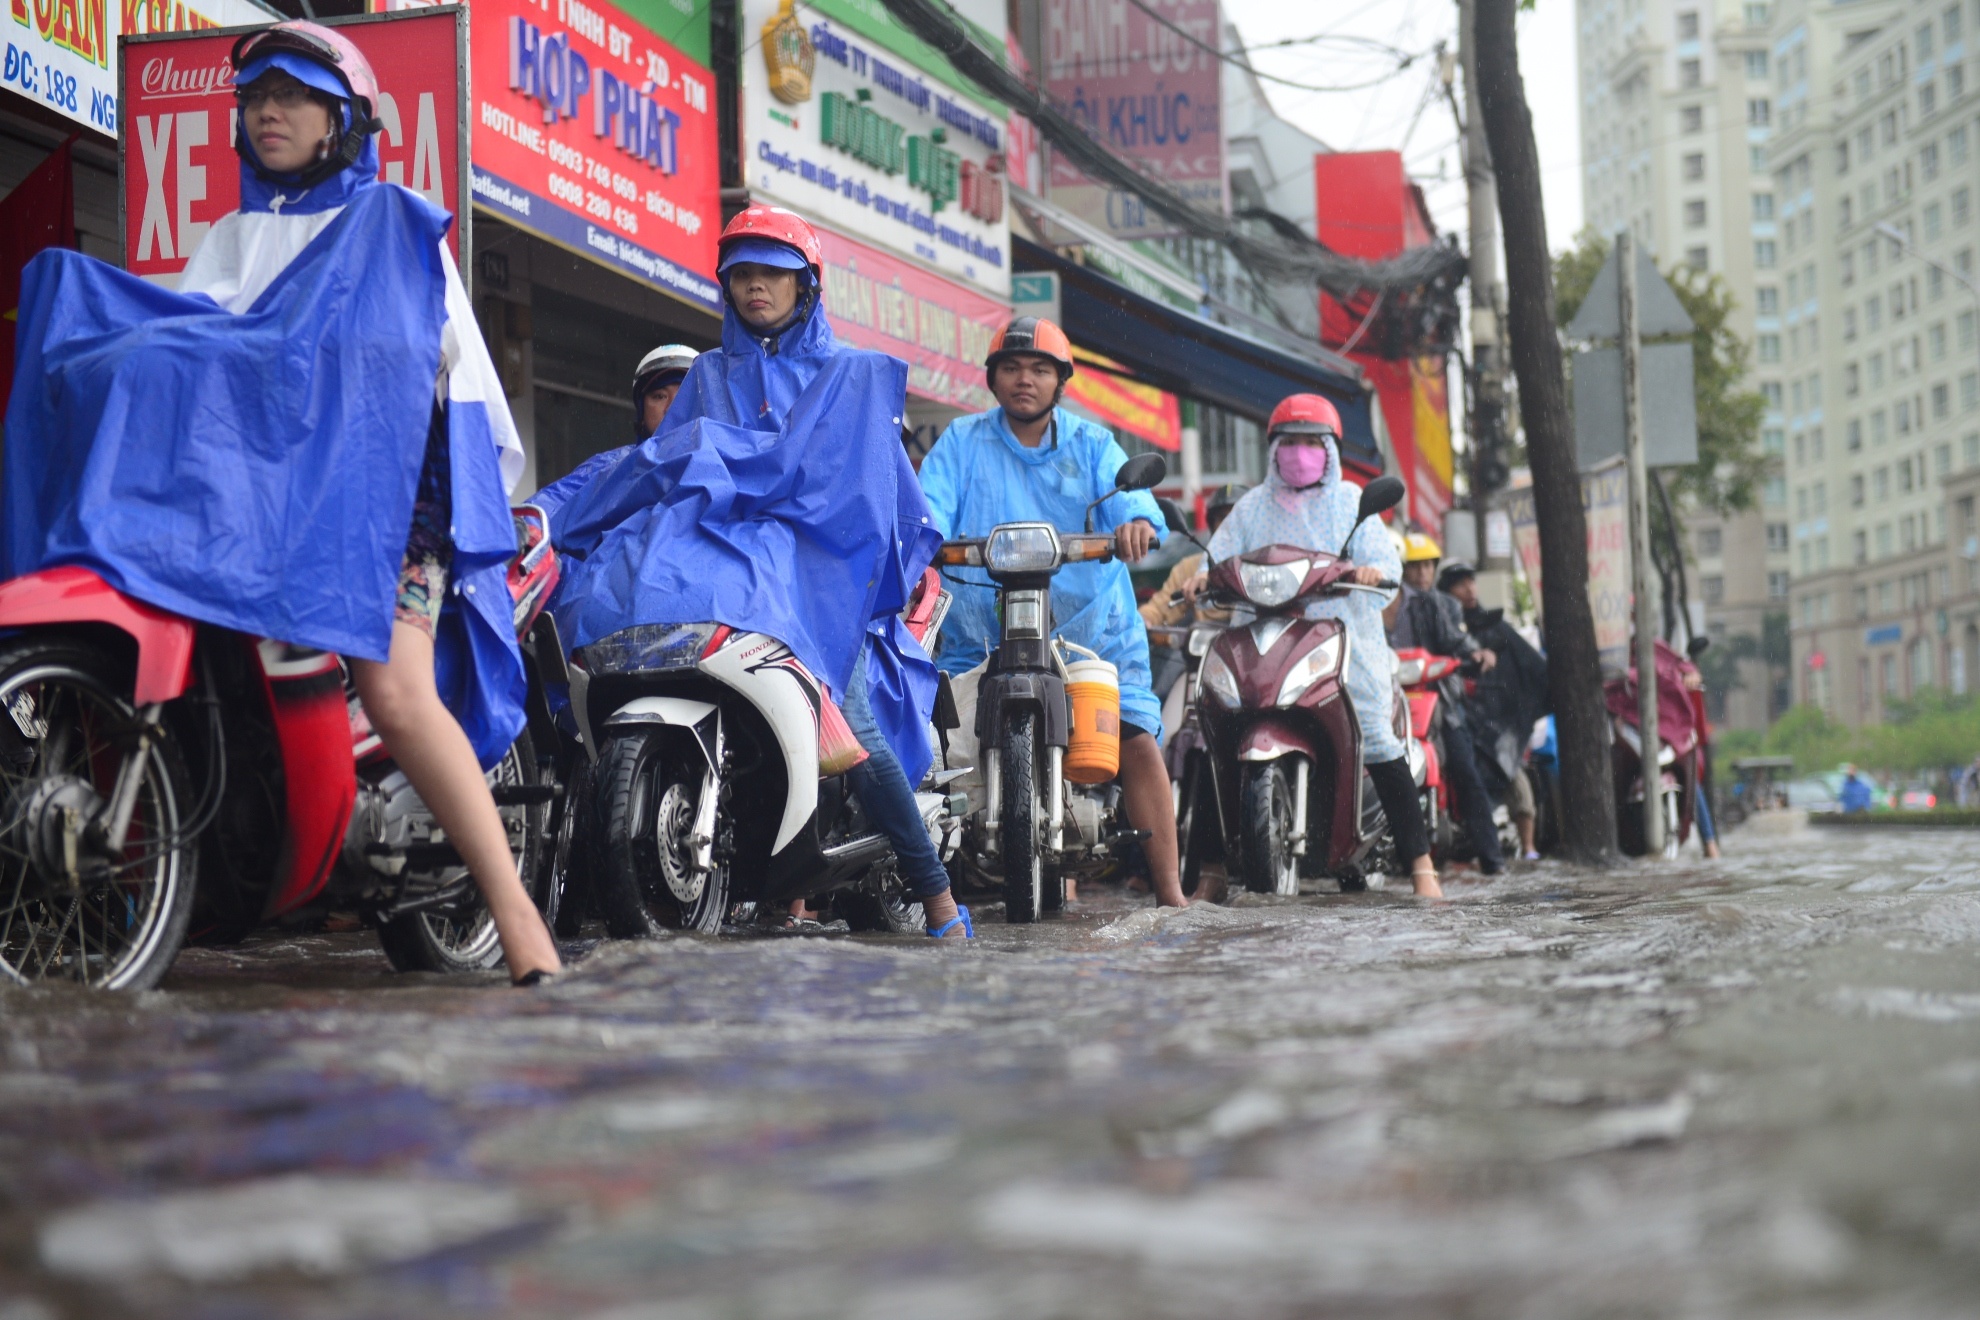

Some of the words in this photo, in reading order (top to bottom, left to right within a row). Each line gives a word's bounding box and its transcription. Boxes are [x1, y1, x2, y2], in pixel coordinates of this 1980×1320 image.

[4, 42, 38, 94] ĐC:
[45, 64, 78, 113] 188
[90, 86, 117, 133] NG
[141, 57, 237, 96] Chuyê
[508, 15, 590, 124] HỢP
[593, 67, 681, 177] PHÁT
[557, 0, 605, 48] TNHH
[608, 24, 632, 64] ĐT
[646, 49, 670, 88] XD
[681, 73, 707, 114] TM
[852, 46, 868, 77] TY
[481, 101, 546, 156] HOTLINE:
[548, 138, 584, 174] 0903
[585, 158, 611, 189] 748
[136, 112, 210, 261] XE
[548, 172, 584, 208] 0908
[612, 207, 638, 235] 436
[875, 275, 916, 344] VIÊN
[739, 638, 776, 660] HONDA
